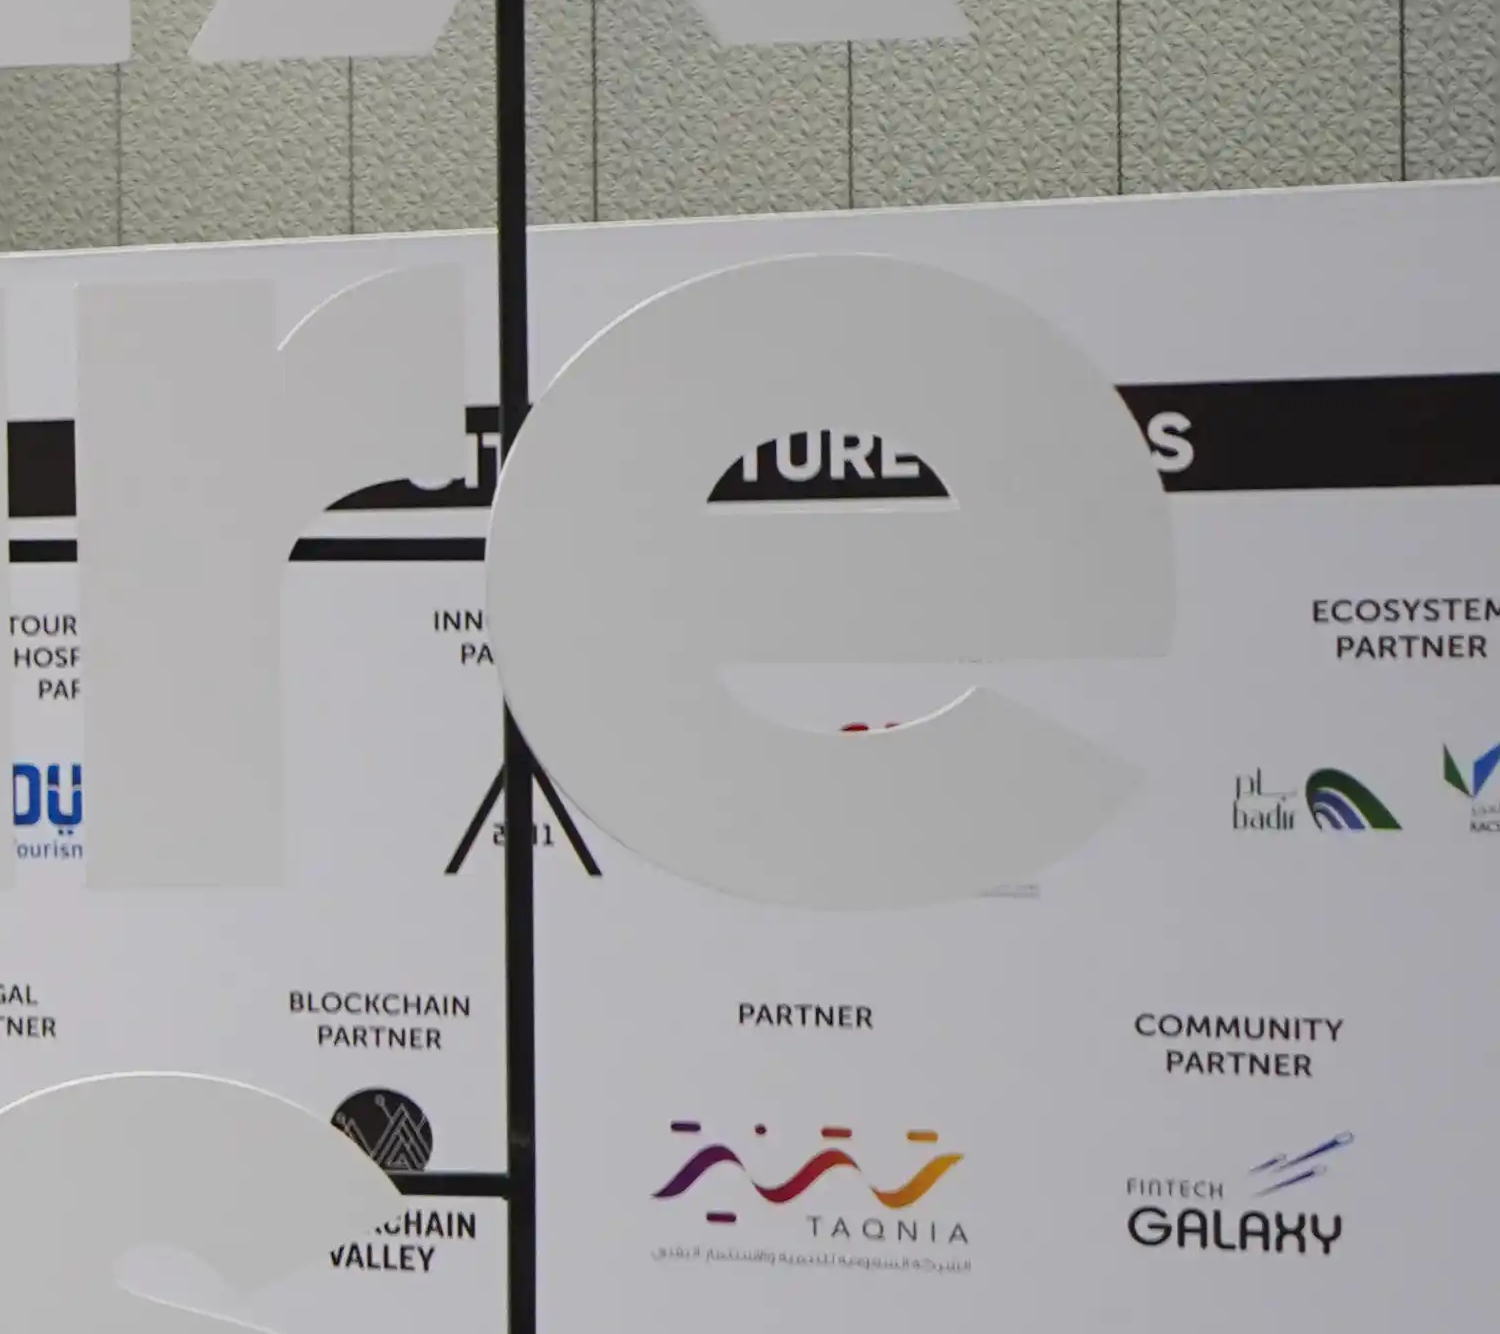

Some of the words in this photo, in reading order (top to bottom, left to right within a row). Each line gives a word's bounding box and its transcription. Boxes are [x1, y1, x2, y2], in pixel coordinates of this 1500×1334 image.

[1336, 635, 1487, 659] PARTNER
[290, 991, 471, 1017] BLOCKCHAIN
[738, 1003, 874, 1029] PARTNER
[318, 1026, 443, 1050] PARTNER
[1135, 1014, 1343, 1041] COMMUNITY
[1167, 1051, 1313, 1077] PARTNER
[807, 1216, 969, 1244] TAQNIA
[1127, 1207, 1343, 1255] GALAXY
